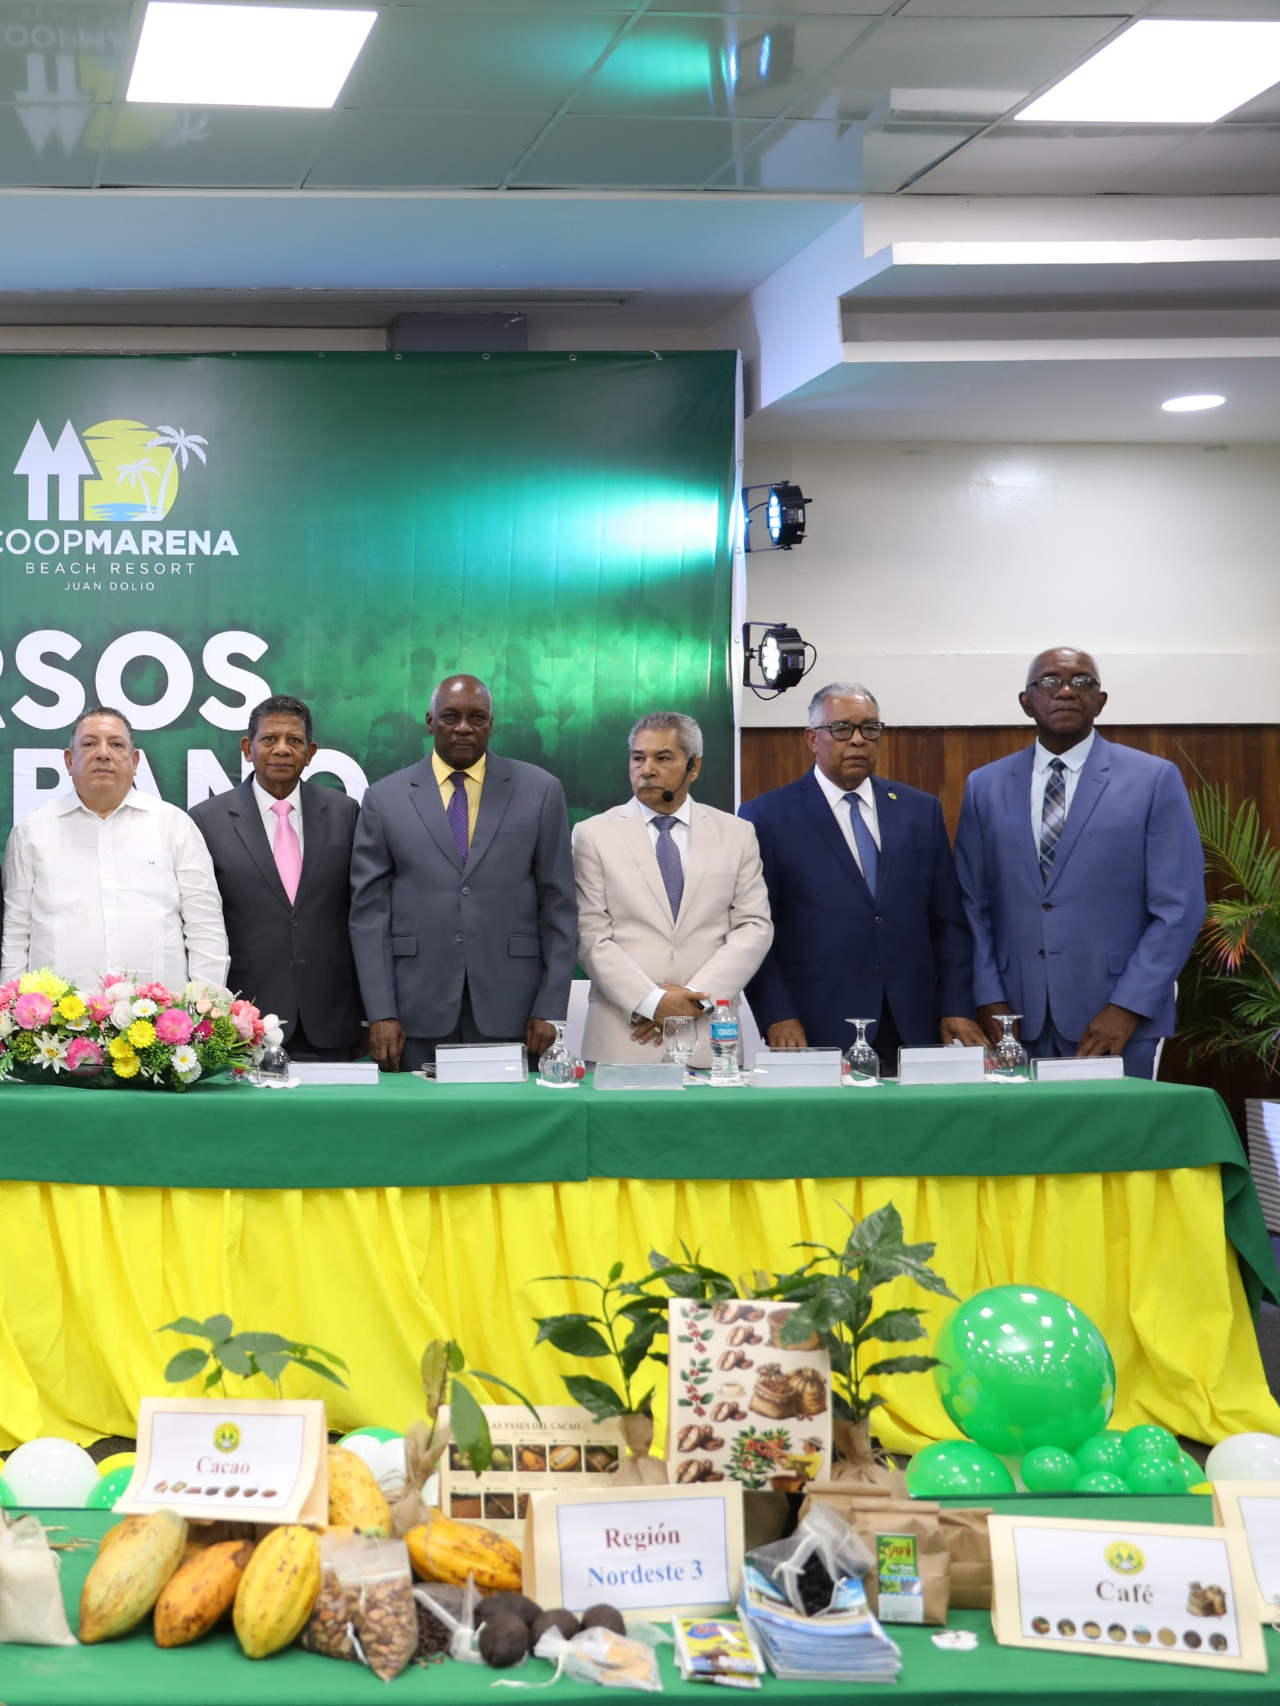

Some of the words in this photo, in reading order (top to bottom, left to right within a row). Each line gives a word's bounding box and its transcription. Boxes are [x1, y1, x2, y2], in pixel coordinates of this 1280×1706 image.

[25, 562, 97, 575] BEACH
[110, 562, 196, 575] RESORT
[64, 581, 103, 591] JUAN
[109, 581, 155, 591] DOLIO
[550, 1422, 581, 1431] CACAO
[196, 1455, 250, 1475] Cacao
[605, 1522, 681, 1552] Región
[587, 1563, 684, 1588] Nordeste
[691, 1559, 703, 1580] 3
[1095, 1580, 1154, 1604] Café
